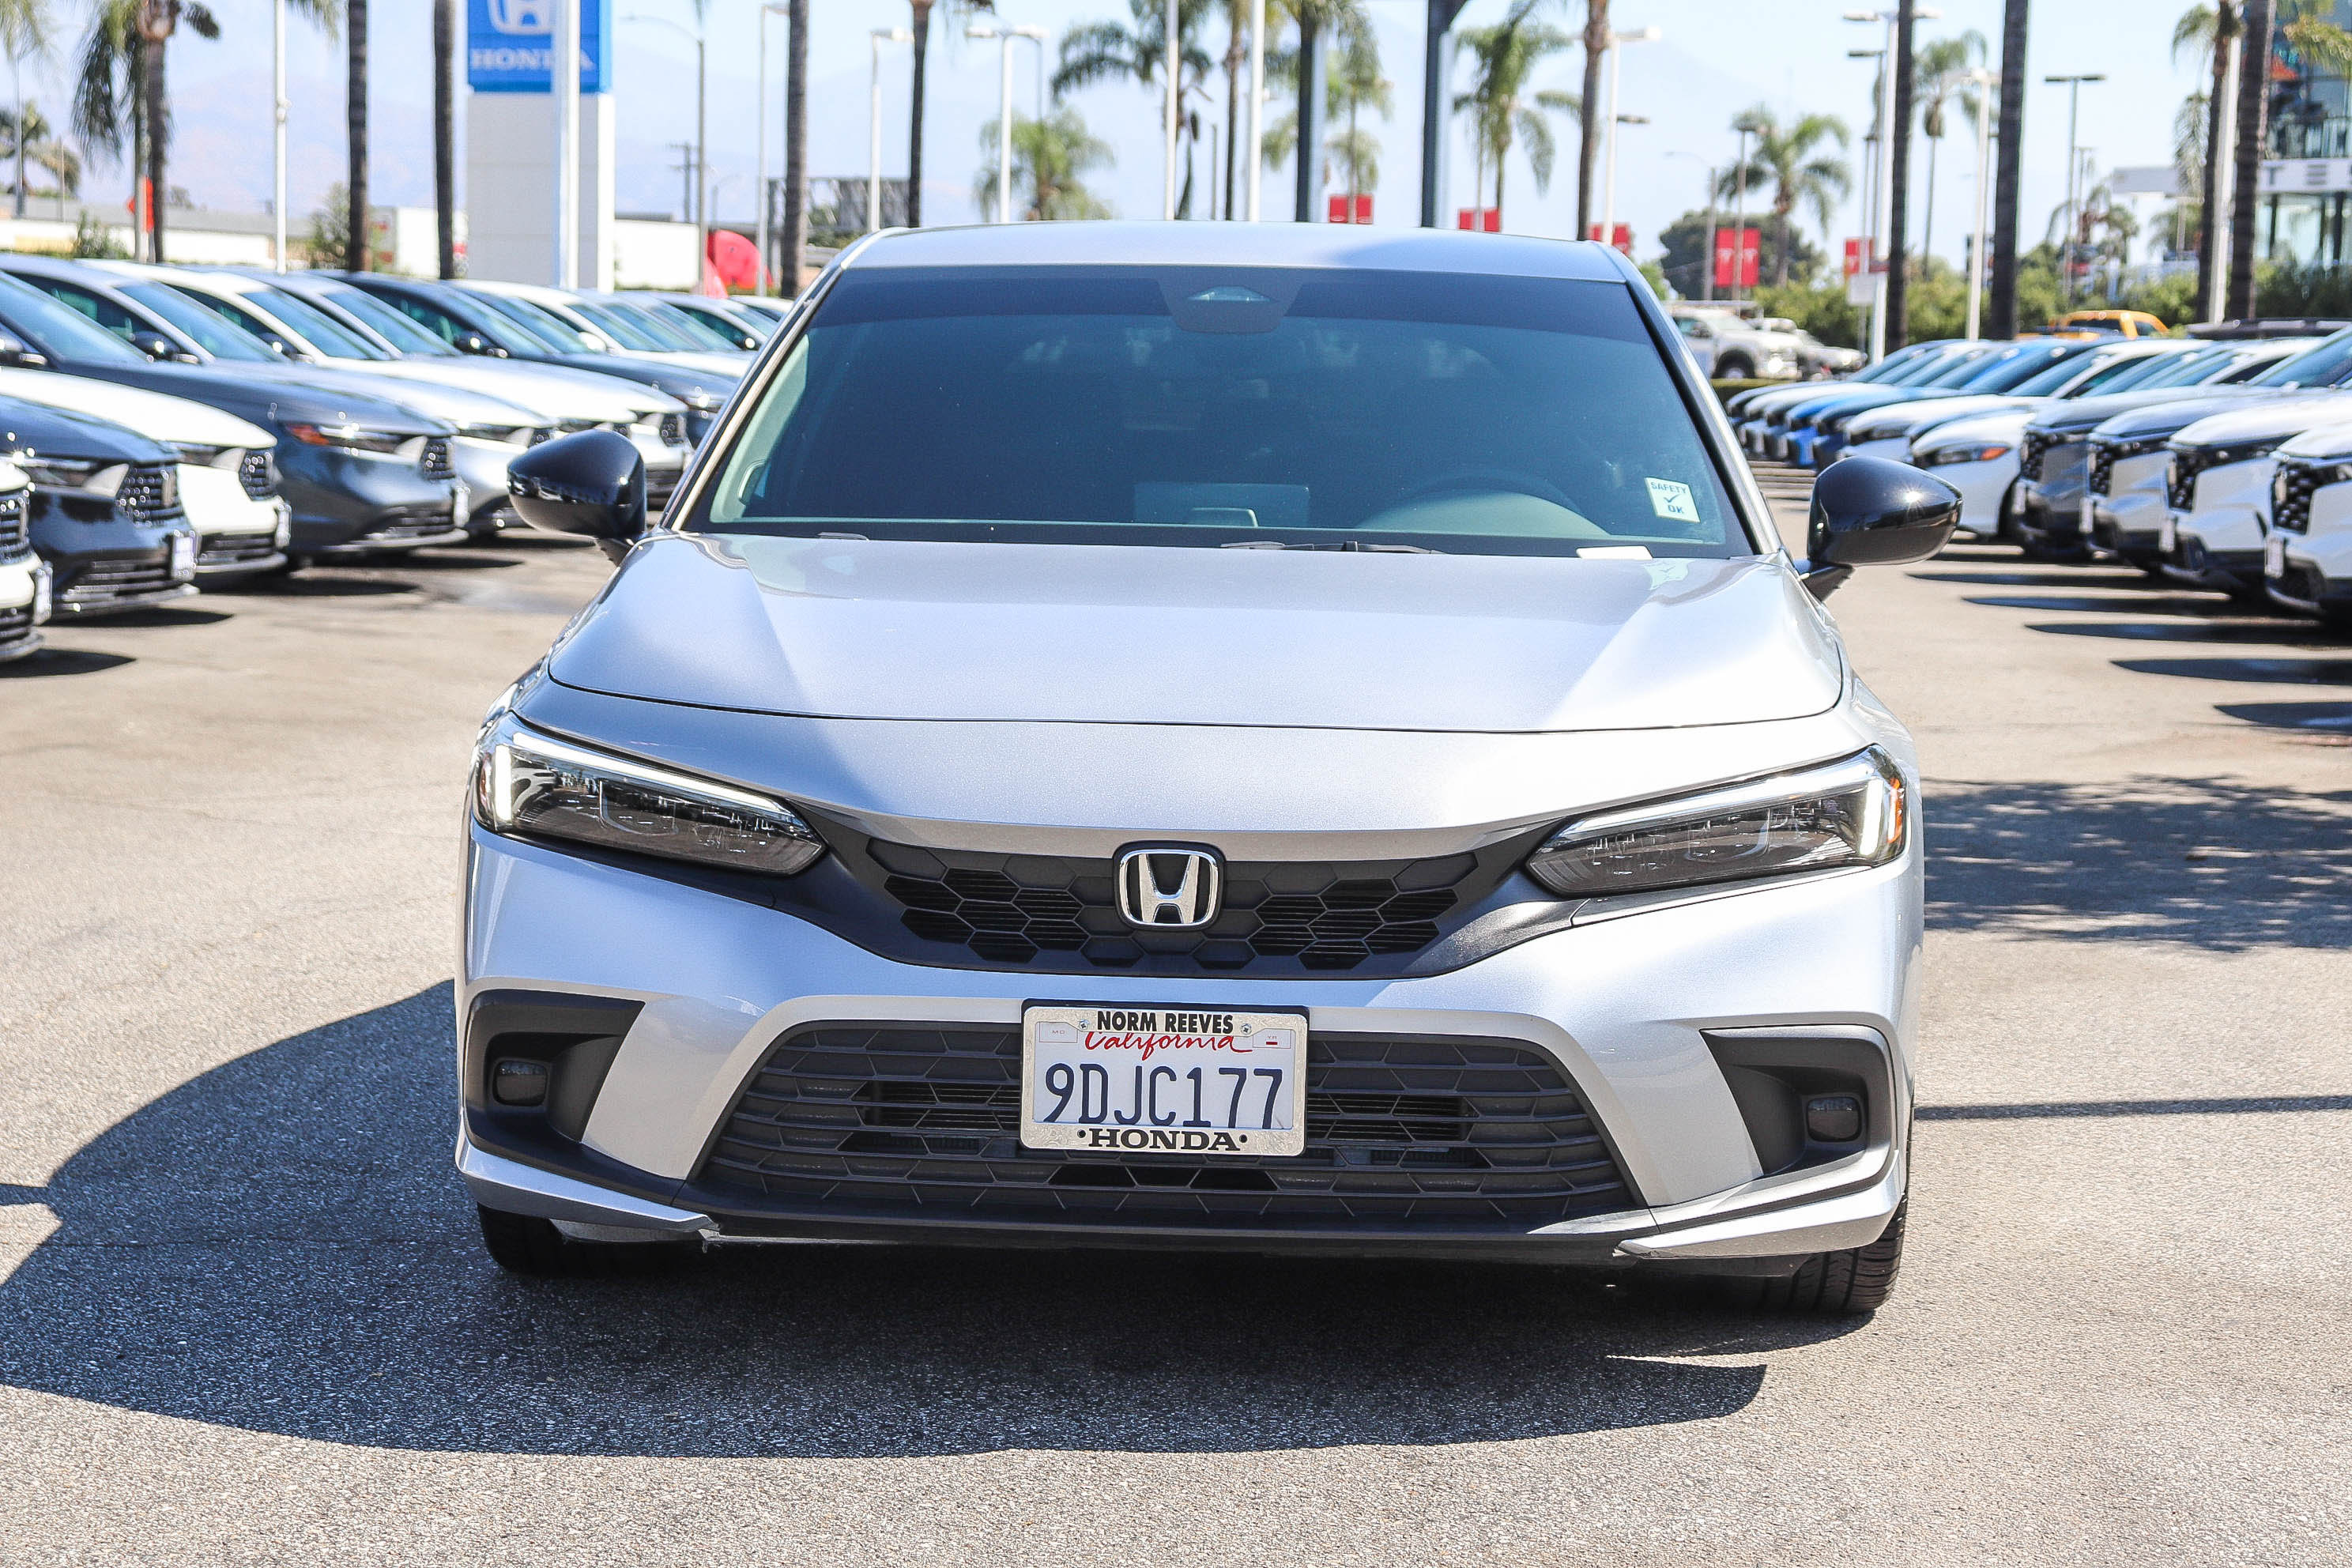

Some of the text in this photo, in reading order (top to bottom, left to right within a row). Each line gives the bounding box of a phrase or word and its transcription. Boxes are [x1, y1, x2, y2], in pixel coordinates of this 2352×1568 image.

[1650, 481, 1687, 494] SAFETY
[1668, 504, 1684, 514] OK
[1097, 1010, 1234, 1035] NORM REEVES
[1084, 1031, 1253, 1061] California
[1042, 1062, 1283, 1130] 9DJC177
[1088, 1127, 1241, 1152] HONDA
